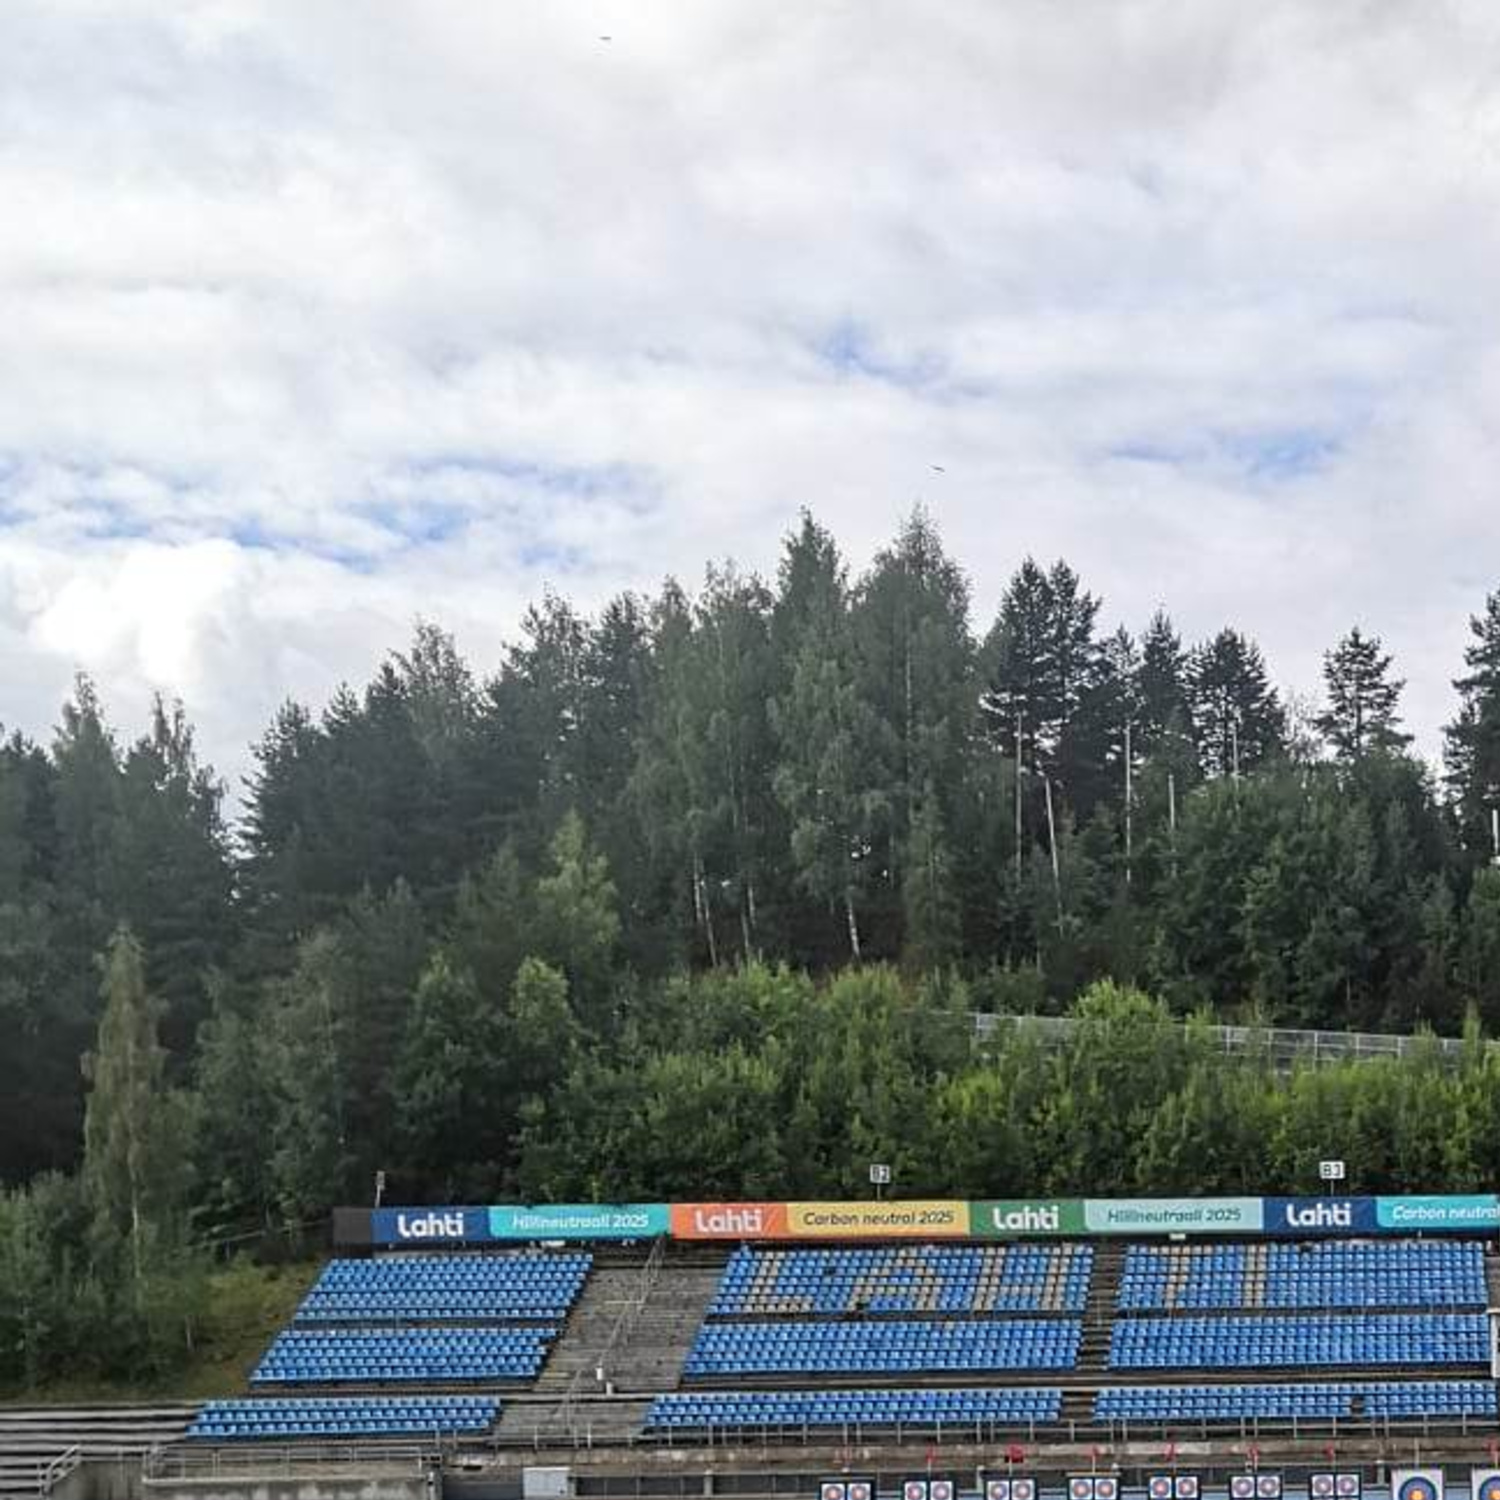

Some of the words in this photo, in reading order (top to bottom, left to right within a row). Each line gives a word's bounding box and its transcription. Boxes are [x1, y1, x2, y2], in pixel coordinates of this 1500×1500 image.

[613, 1213, 649, 1228] 2025
[694, 1208, 762, 1233] Lahti
[803, 1212, 860, 1226] Carbon
[863, 1211, 915, 1225] neutral
[919, 1211, 954, 1224] 2025
[993, 1205, 1059, 1230] Lahti
[1206, 1208, 1241, 1221] 2025
[1286, 1201, 1351, 1226] Lahti
[1392, 1204, 1445, 1220] Carbon
[1448, 1204, 1500, 1219] neutral
[397, 1212, 464, 1237] Lahti
